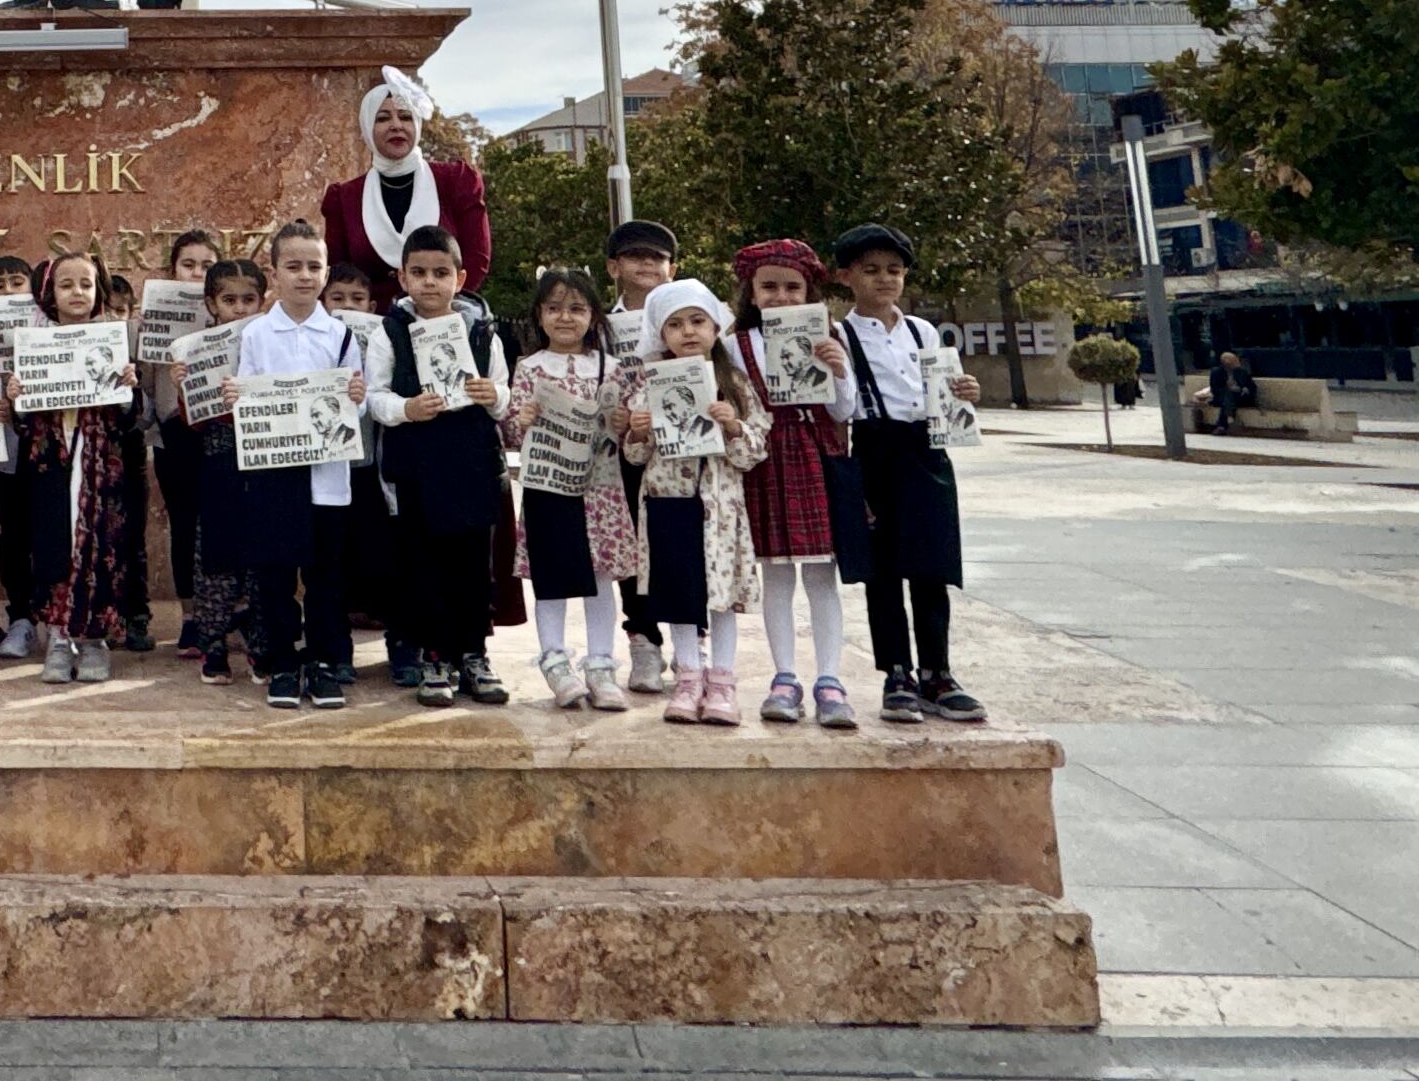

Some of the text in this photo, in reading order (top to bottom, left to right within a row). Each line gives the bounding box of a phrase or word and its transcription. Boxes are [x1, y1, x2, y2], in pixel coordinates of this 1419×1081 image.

[938, 322, 1058, 356] OFFEE
[20, 370, 48, 381] YARIN
[238, 402, 298, 418] EFENDİLER!
[240, 421, 271, 434] YARIN
[242, 432, 312, 451] CUMHURİYETİ
[531, 431, 561, 450] YARIN
